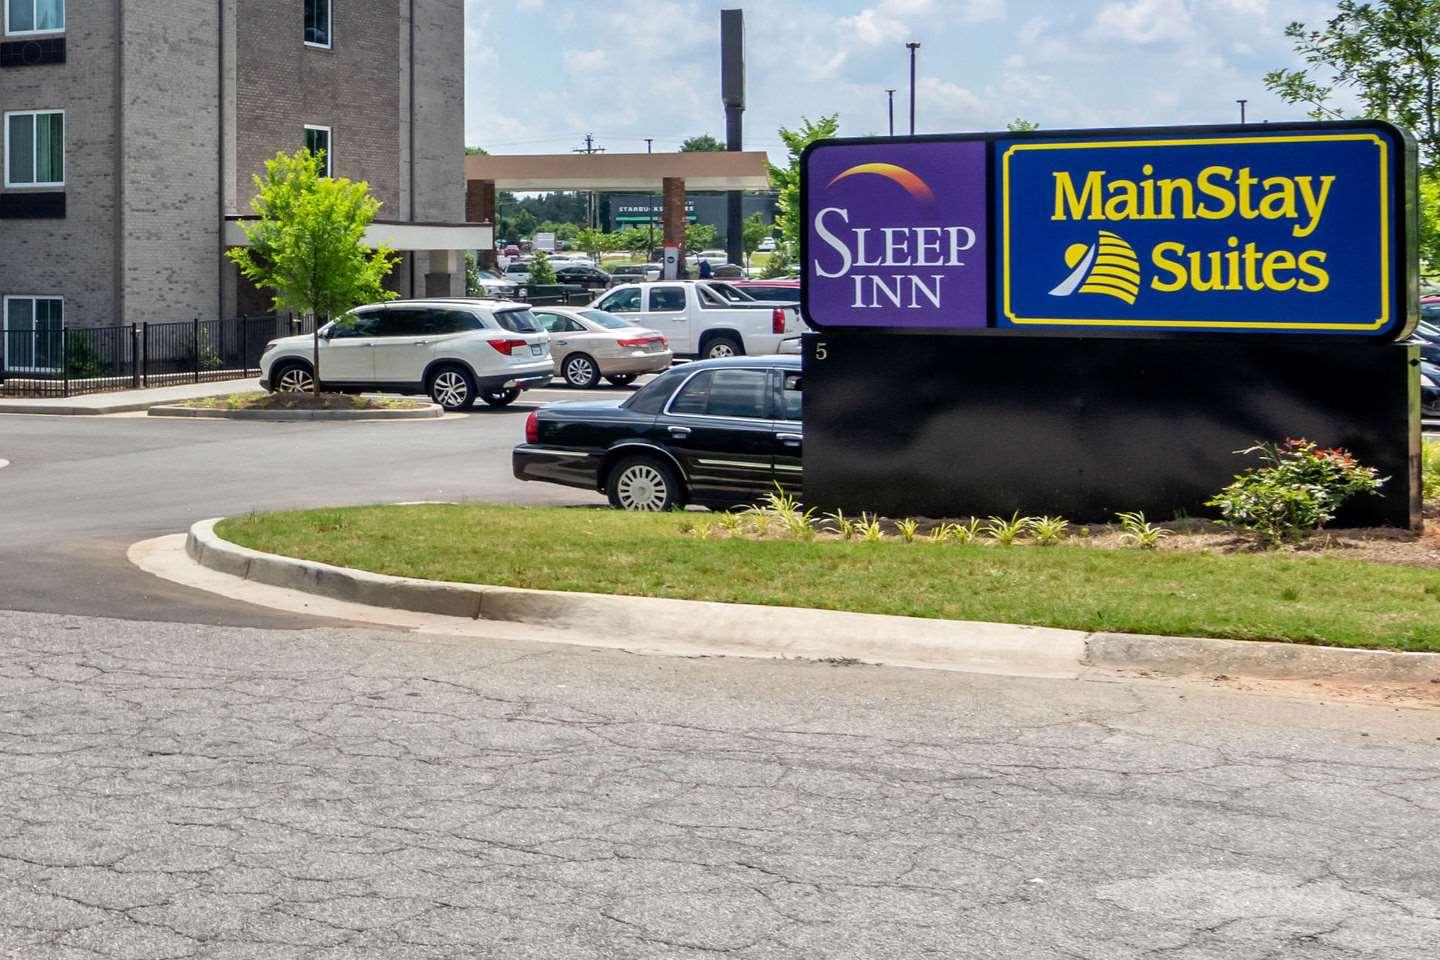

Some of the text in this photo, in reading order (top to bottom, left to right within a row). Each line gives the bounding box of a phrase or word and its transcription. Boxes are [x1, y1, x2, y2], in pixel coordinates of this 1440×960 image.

[1051, 164, 1336, 238] MainStay
[815, 208, 977, 279] SLEEP
[1151, 236, 1331, 293] Suites
[851, 274, 944, 309] INN
[816, 342, 828, 360] 5
